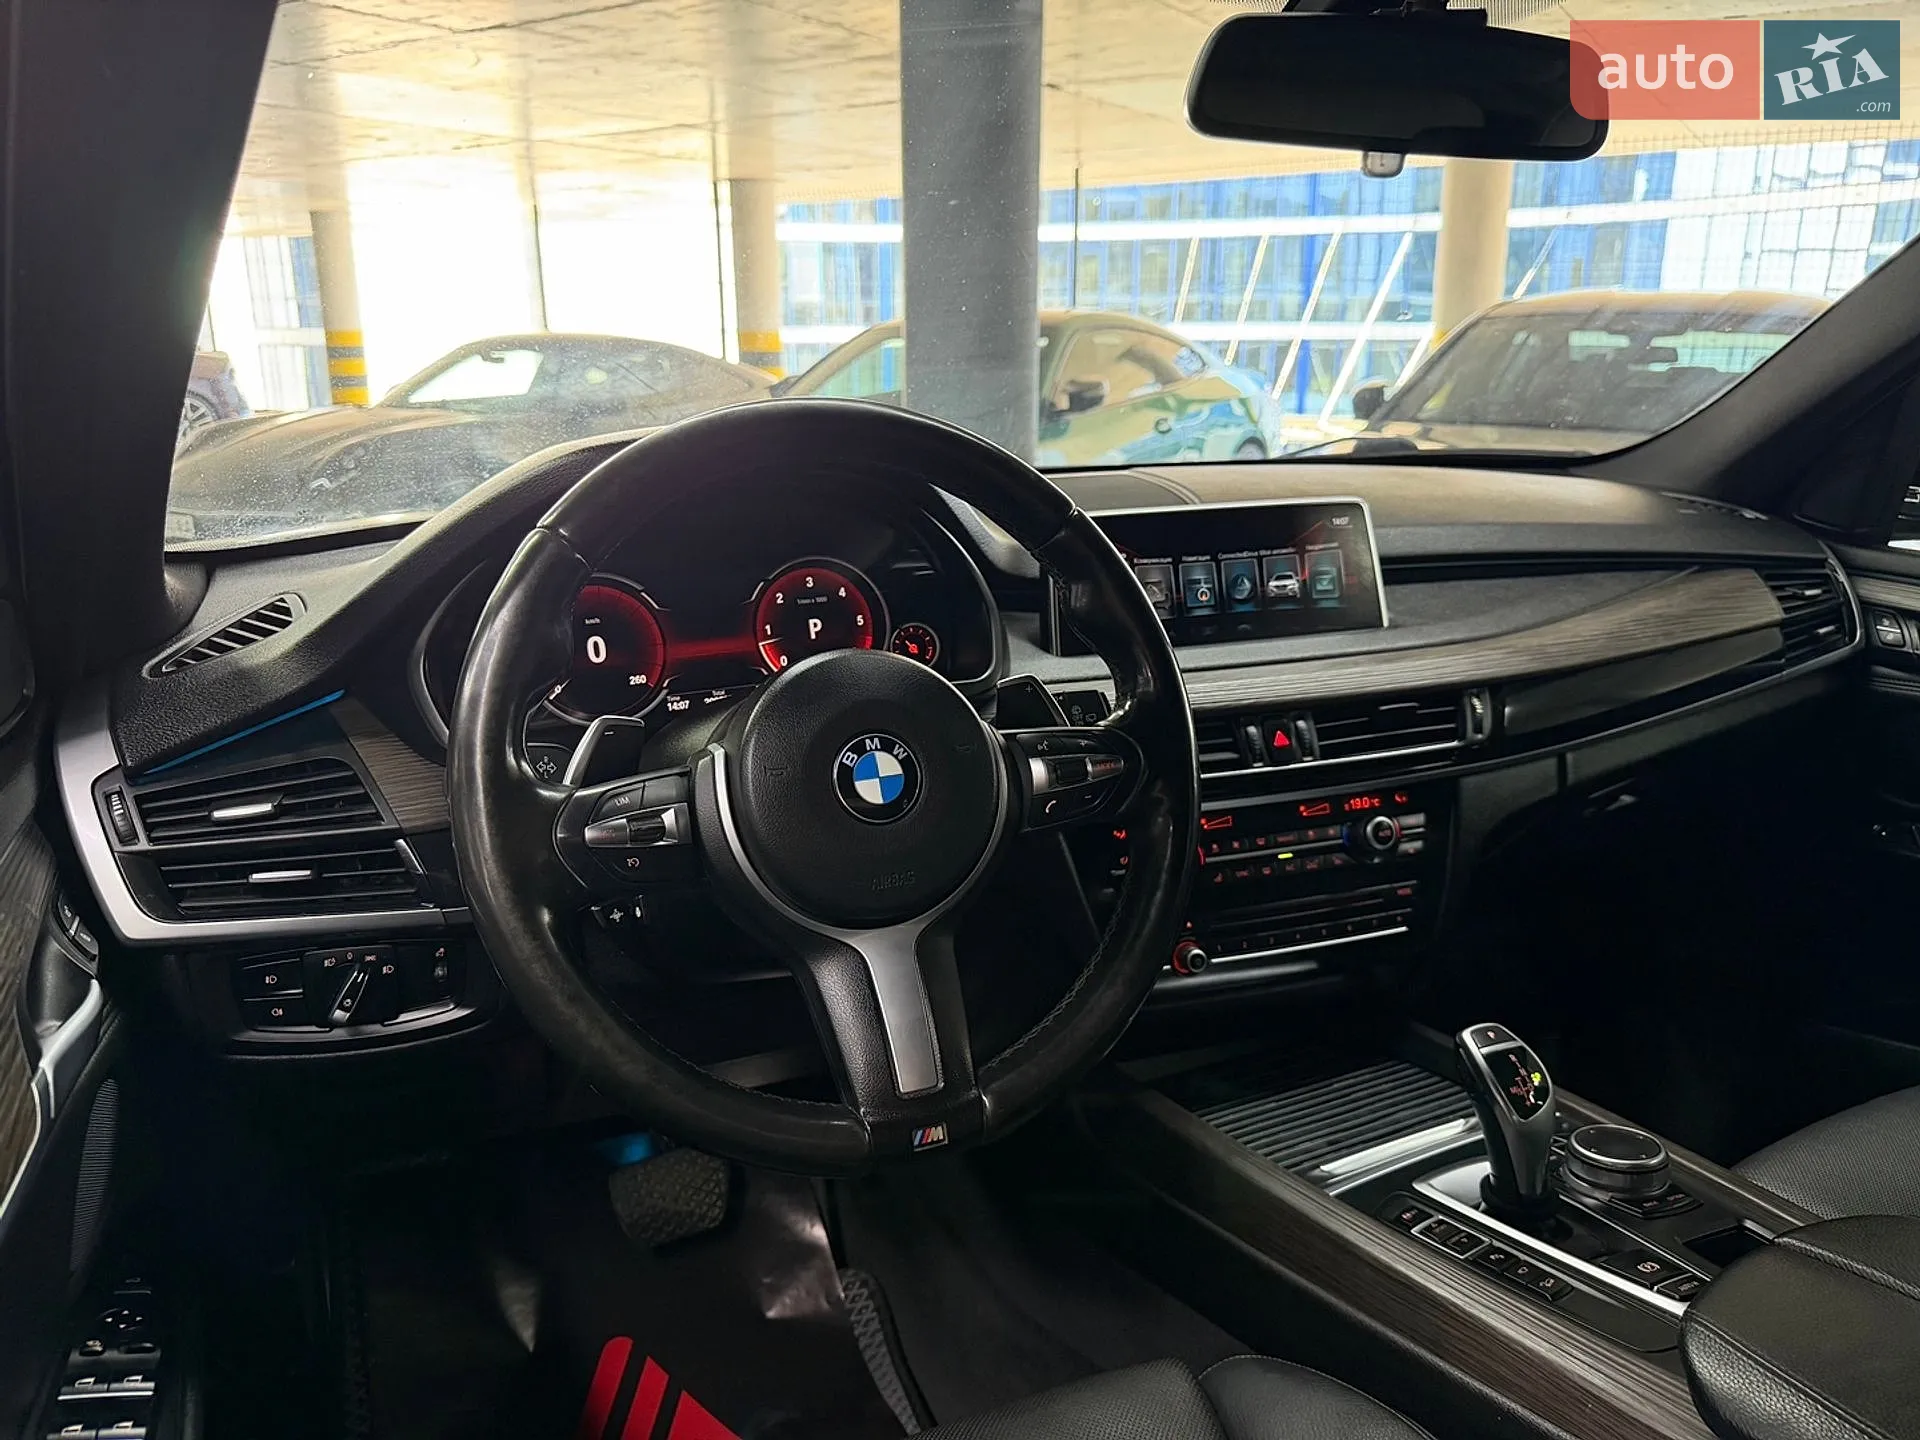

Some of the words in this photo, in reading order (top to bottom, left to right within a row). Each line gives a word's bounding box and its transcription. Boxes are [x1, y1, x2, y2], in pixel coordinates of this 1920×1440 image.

[805, 576, 814, 588] 3
[776, 592, 784, 604] 2
[838, 587, 847, 598] 4
[856, 614, 864, 626] 5
[764, 623, 772, 636] 1
[808, 618, 823, 641] P
[586, 634, 607, 664] 0
[779, 655, 788, 667] 0
[629, 674, 647, 686] 260
[667, 700, 690, 712] 14:07
